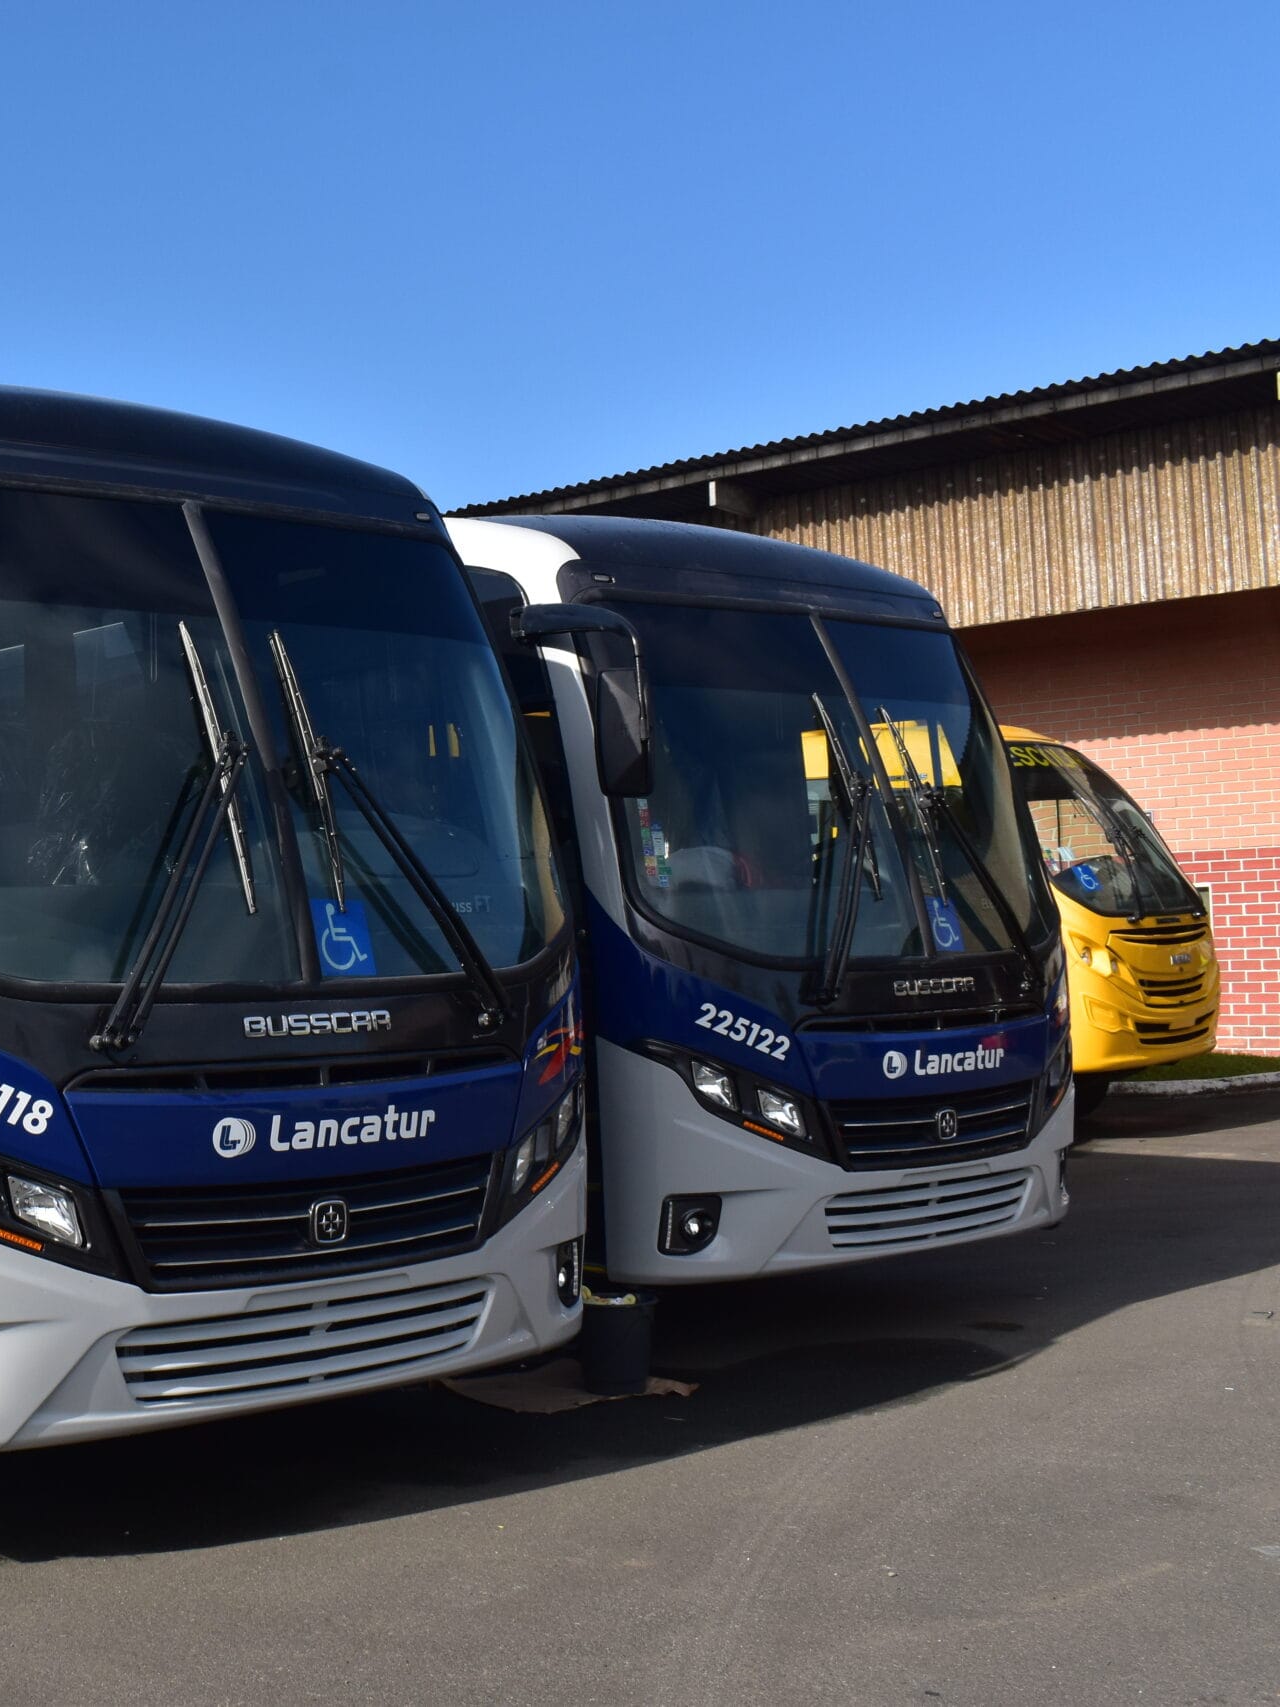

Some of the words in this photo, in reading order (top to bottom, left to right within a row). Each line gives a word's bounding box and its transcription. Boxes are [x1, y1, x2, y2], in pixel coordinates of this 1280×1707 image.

[893, 976, 976, 996] BUSSCAR
[243, 1009, 392, 1038] BUSSCAR
[694, 1002, 791, 1061] 225122
[914, 1044, 1005, 1076] Lancatur
[270, 1104, 436, 1152] Lancatur
